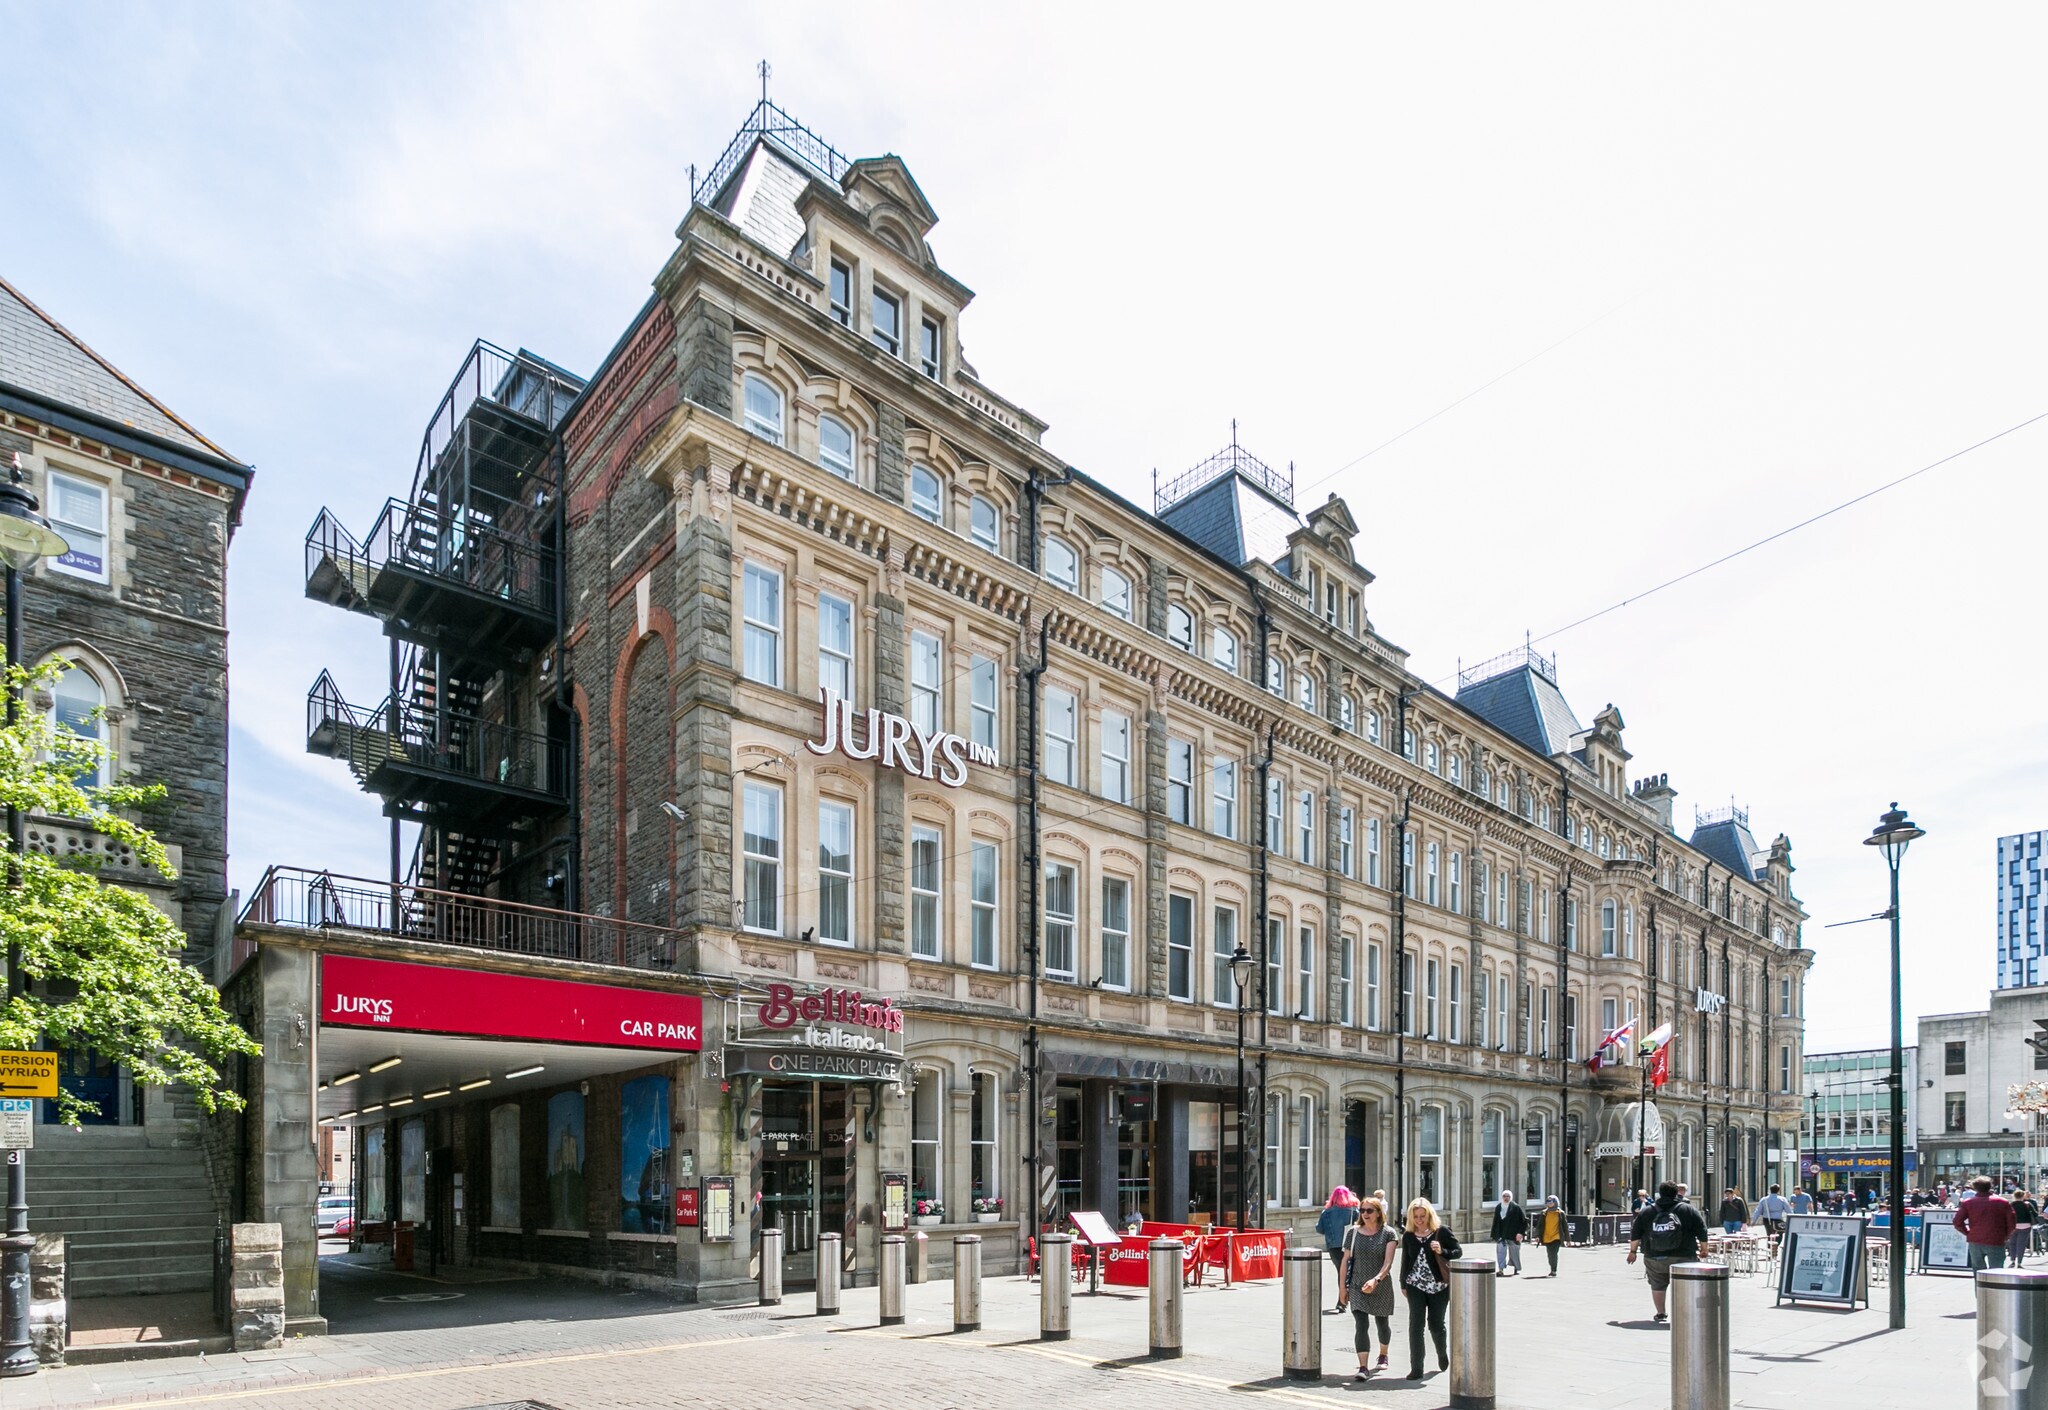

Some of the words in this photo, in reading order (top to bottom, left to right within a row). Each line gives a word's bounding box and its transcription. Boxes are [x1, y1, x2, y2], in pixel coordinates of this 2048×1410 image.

[76, 557, 99, 568] RICS
[805, 686, 968, 788] JURYS
[967, 741, 1000, 768] INN
[331, 993, 393, 1015] JURYS
[1695, 986, 1719, 1015] JURYS
[373, 1014, 390, 1023] INN
[620, 1020, 653, 1037] CAR
[657, 1023, 696, 1040] PARK
[1, 1055, 54, 1066] ERSION
[768, 1054, 810, 1071] ONE
[814, 1055, 857, 1074] PARK
[860, 1058, 896, 1079] PLACE
[768, 1132, 788, 1141] PARK
[8, 1152, 17, 1163] 3
[1827, 1159, 1854, 1167] Card
[684, 1209, 692, 1217] Park
[1652, 1222, 1676, 1232] VANS
[1804, 1220, 1844, 1231] HENRY'S
[1109, 1247, 1150, 1262] Bellini's
[1241, 1245, 1278, 1262] Bellini's
[1800, 1258, 1839, 1268] COCKTAILS
